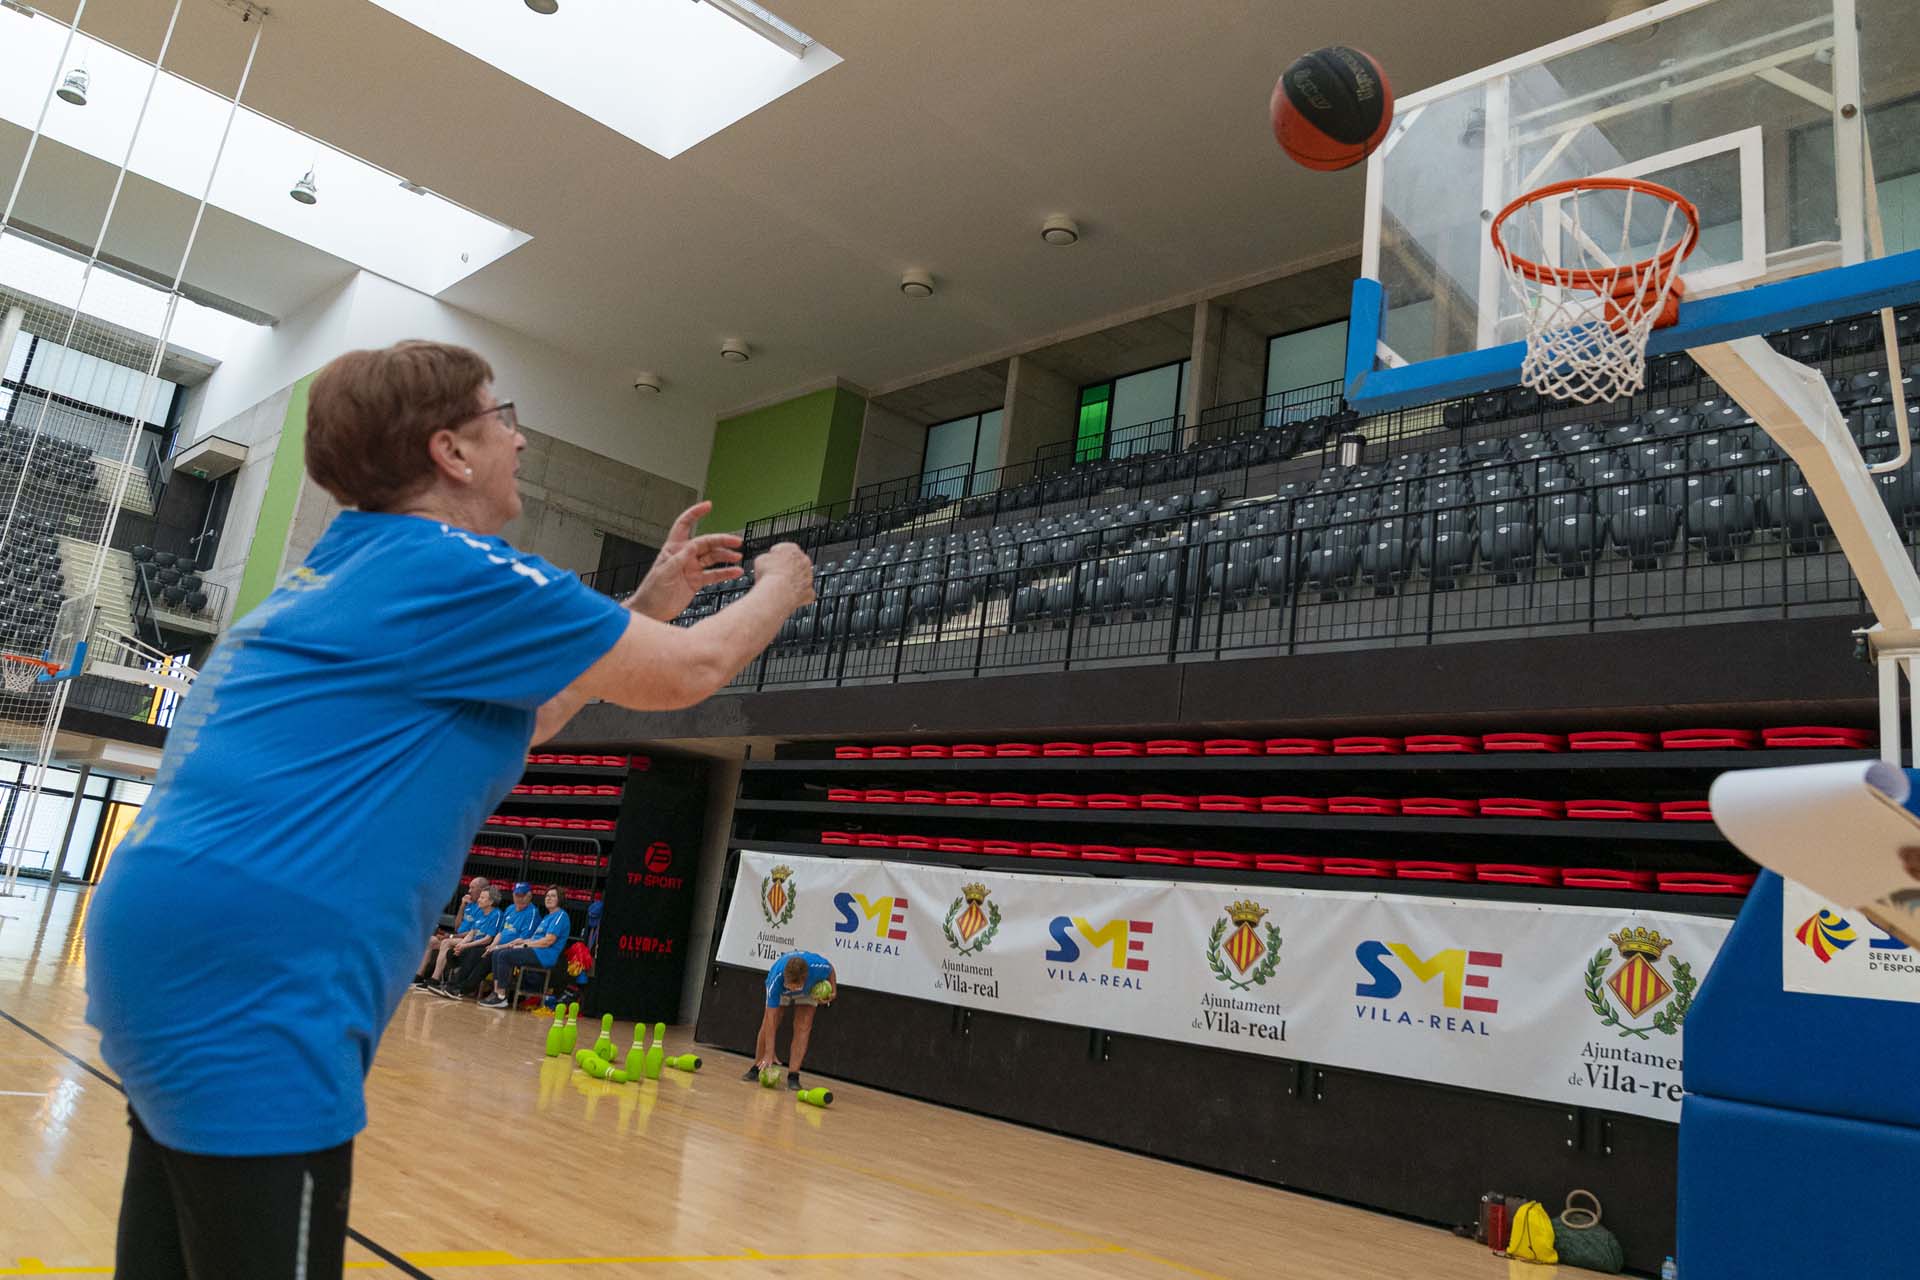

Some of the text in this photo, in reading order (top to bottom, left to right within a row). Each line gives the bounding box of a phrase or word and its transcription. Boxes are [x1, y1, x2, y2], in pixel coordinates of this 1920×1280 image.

[626, 872, 643, 886] TP
[833, 892, 909, 941] SME
[757, 931, 795, 945] Ajuntament
[835, 937, 901, 956] VILA-REAL
[1045, 916, 1154, 972] SME
[941, 958, 993, 977] Ajuntament
[1869, 952, 1913, 963] SERVEI
[943, 973, 999, 999] Vila-real
[1047, 968, 1143, 991] VILA-REAL
[1355, 940, 1503, 1014] SME
[1200, 992, 1281, 1016] Ajuntament
[1191, 1010, 1287, 1041] de Vila-real
[1356, 1005, 1490, 1036] VILA-REAL
[1581, 1041, 1684, 1071] Ajuntame
[1568, 1062, 1683, 1103] de Vila-re
